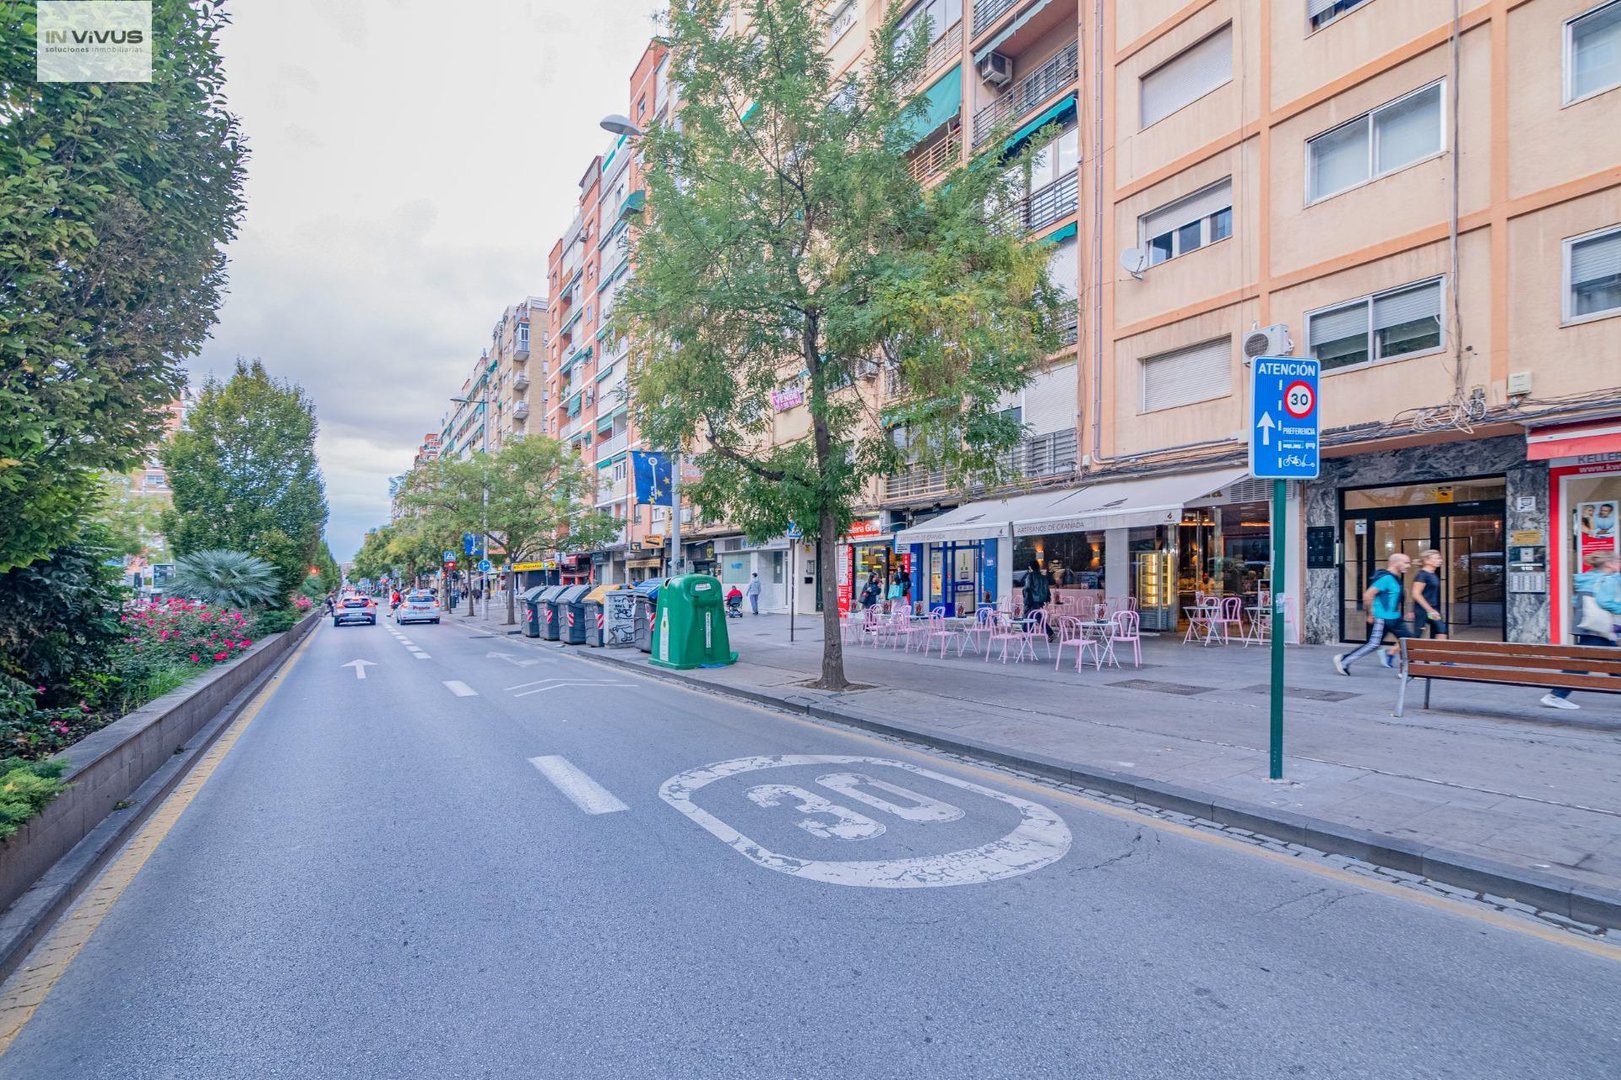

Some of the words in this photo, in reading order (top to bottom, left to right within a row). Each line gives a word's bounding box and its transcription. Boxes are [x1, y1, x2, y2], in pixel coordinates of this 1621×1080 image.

[1258, 362, 1316, 377] ATENCIÓN
[1290, 393, 1309, 406] 30
[1282, 427, 1316, 436] PREFERENCIA
[1048, 523, 1056, 531] DE
[1056, 521, 1085, 531] GRANADA
[744, 772, 966, 841] 30
